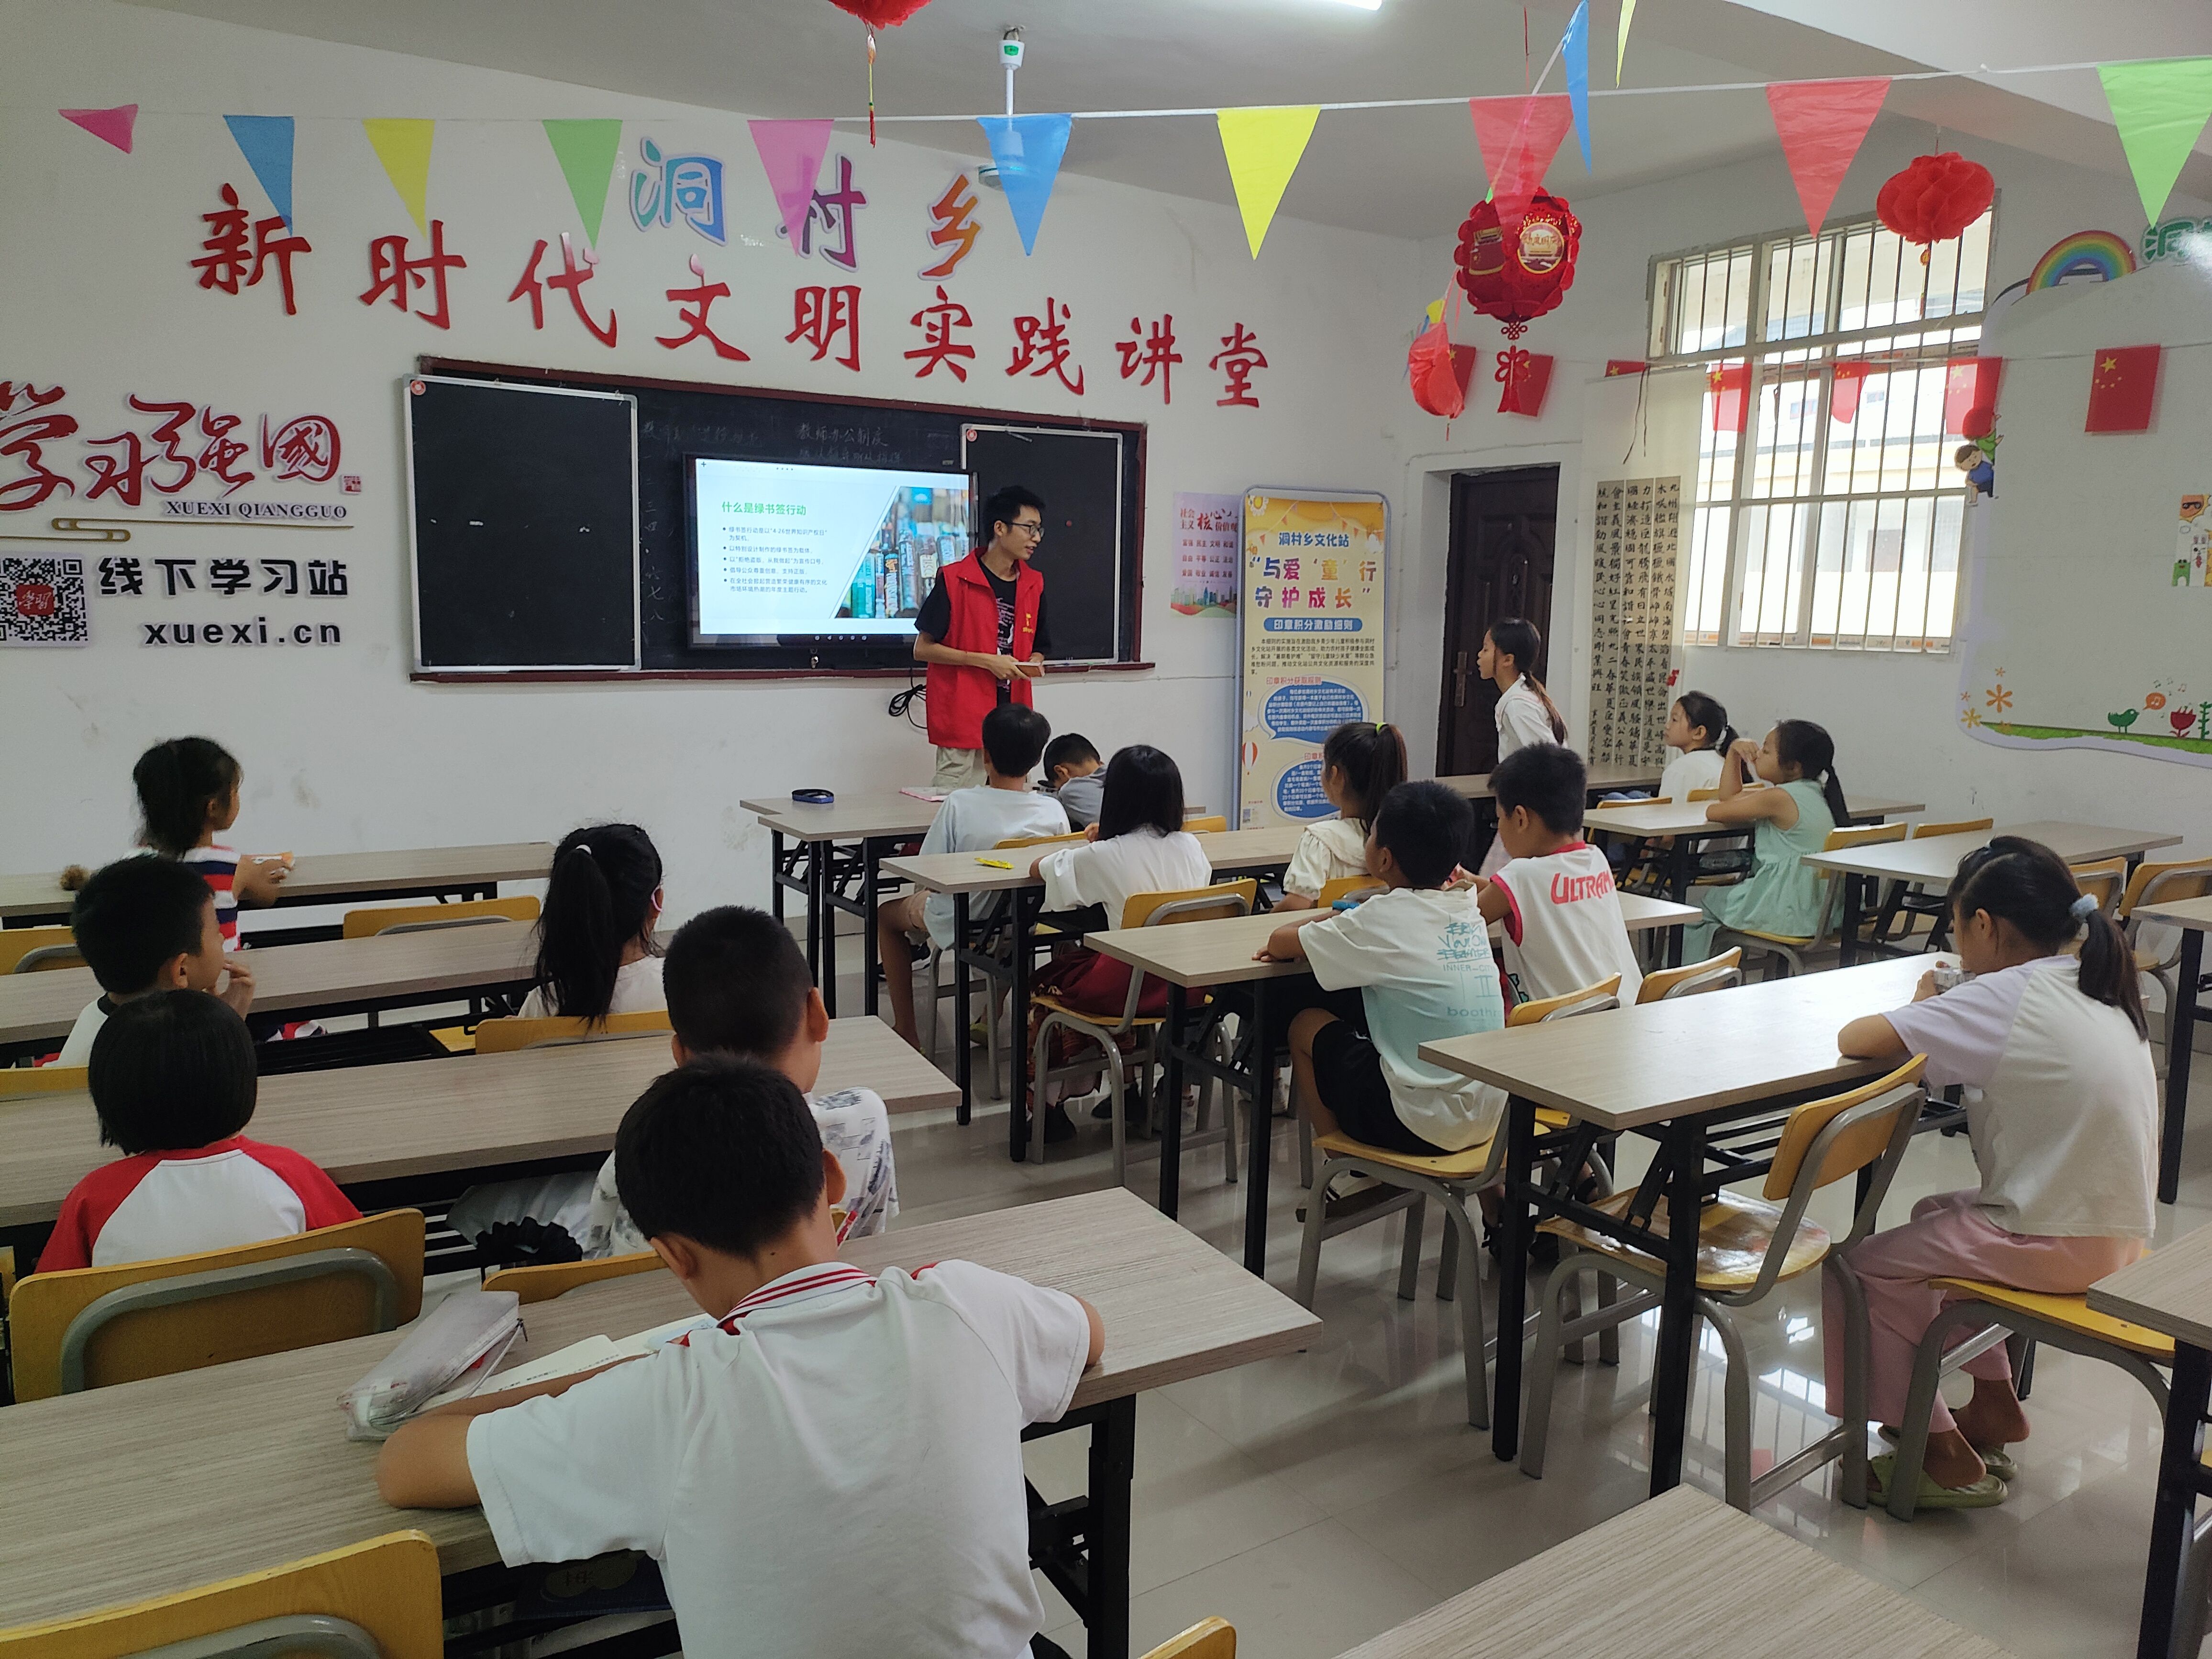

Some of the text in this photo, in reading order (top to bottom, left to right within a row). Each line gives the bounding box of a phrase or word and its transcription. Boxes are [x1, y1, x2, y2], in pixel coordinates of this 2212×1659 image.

[629, 136, 984, 281] 洞村乡
[191, 183, 1268, 408] 新时代文明实践讲堂
[167, 501, 347, 519] XUEXI QIANGGUO
[722, 501, 807, 516] 什么是绿书签行动
[1279, 532, 1349, 547] 洞村乡文化站
[99, 557, 348, 596] 线下学习站
[647, 586, 664, 600] 七
[145, 617, 341, 645] xuexi.cn
